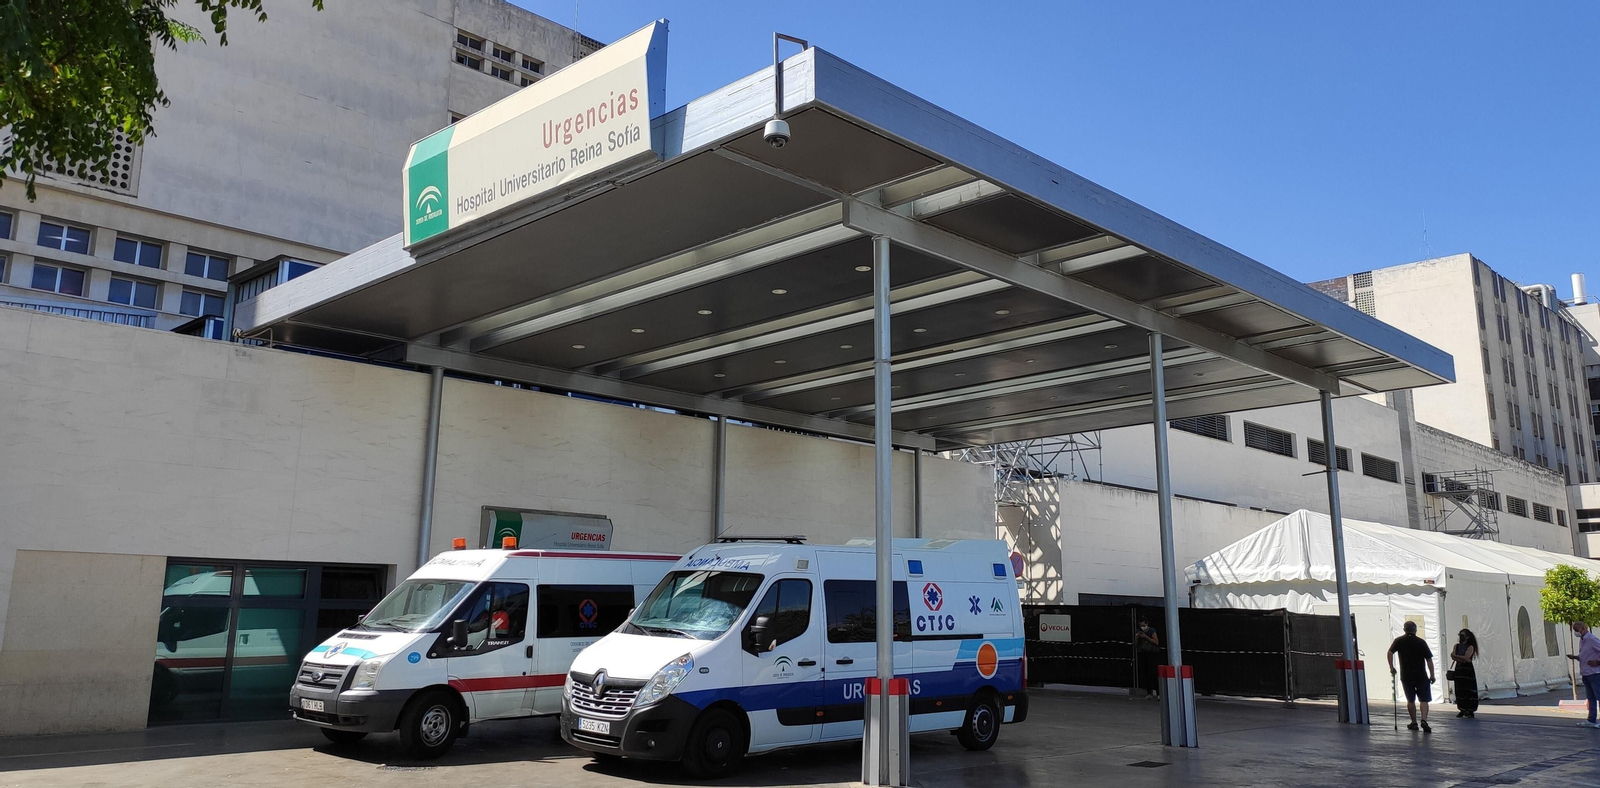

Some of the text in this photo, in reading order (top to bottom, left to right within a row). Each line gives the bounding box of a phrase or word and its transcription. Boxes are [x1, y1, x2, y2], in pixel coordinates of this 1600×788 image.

[542, 87, 639, 149] Urgencias
[456, 123, 641, 214] Hospital Universitario Reina Sofía
[571, 532, 606, 542] URGENCIAS
[579, 621, 598, 629] CTSC
[916, 614, 955, 632] CTSC
[582, 719, 609, 733] 5235 KZN
